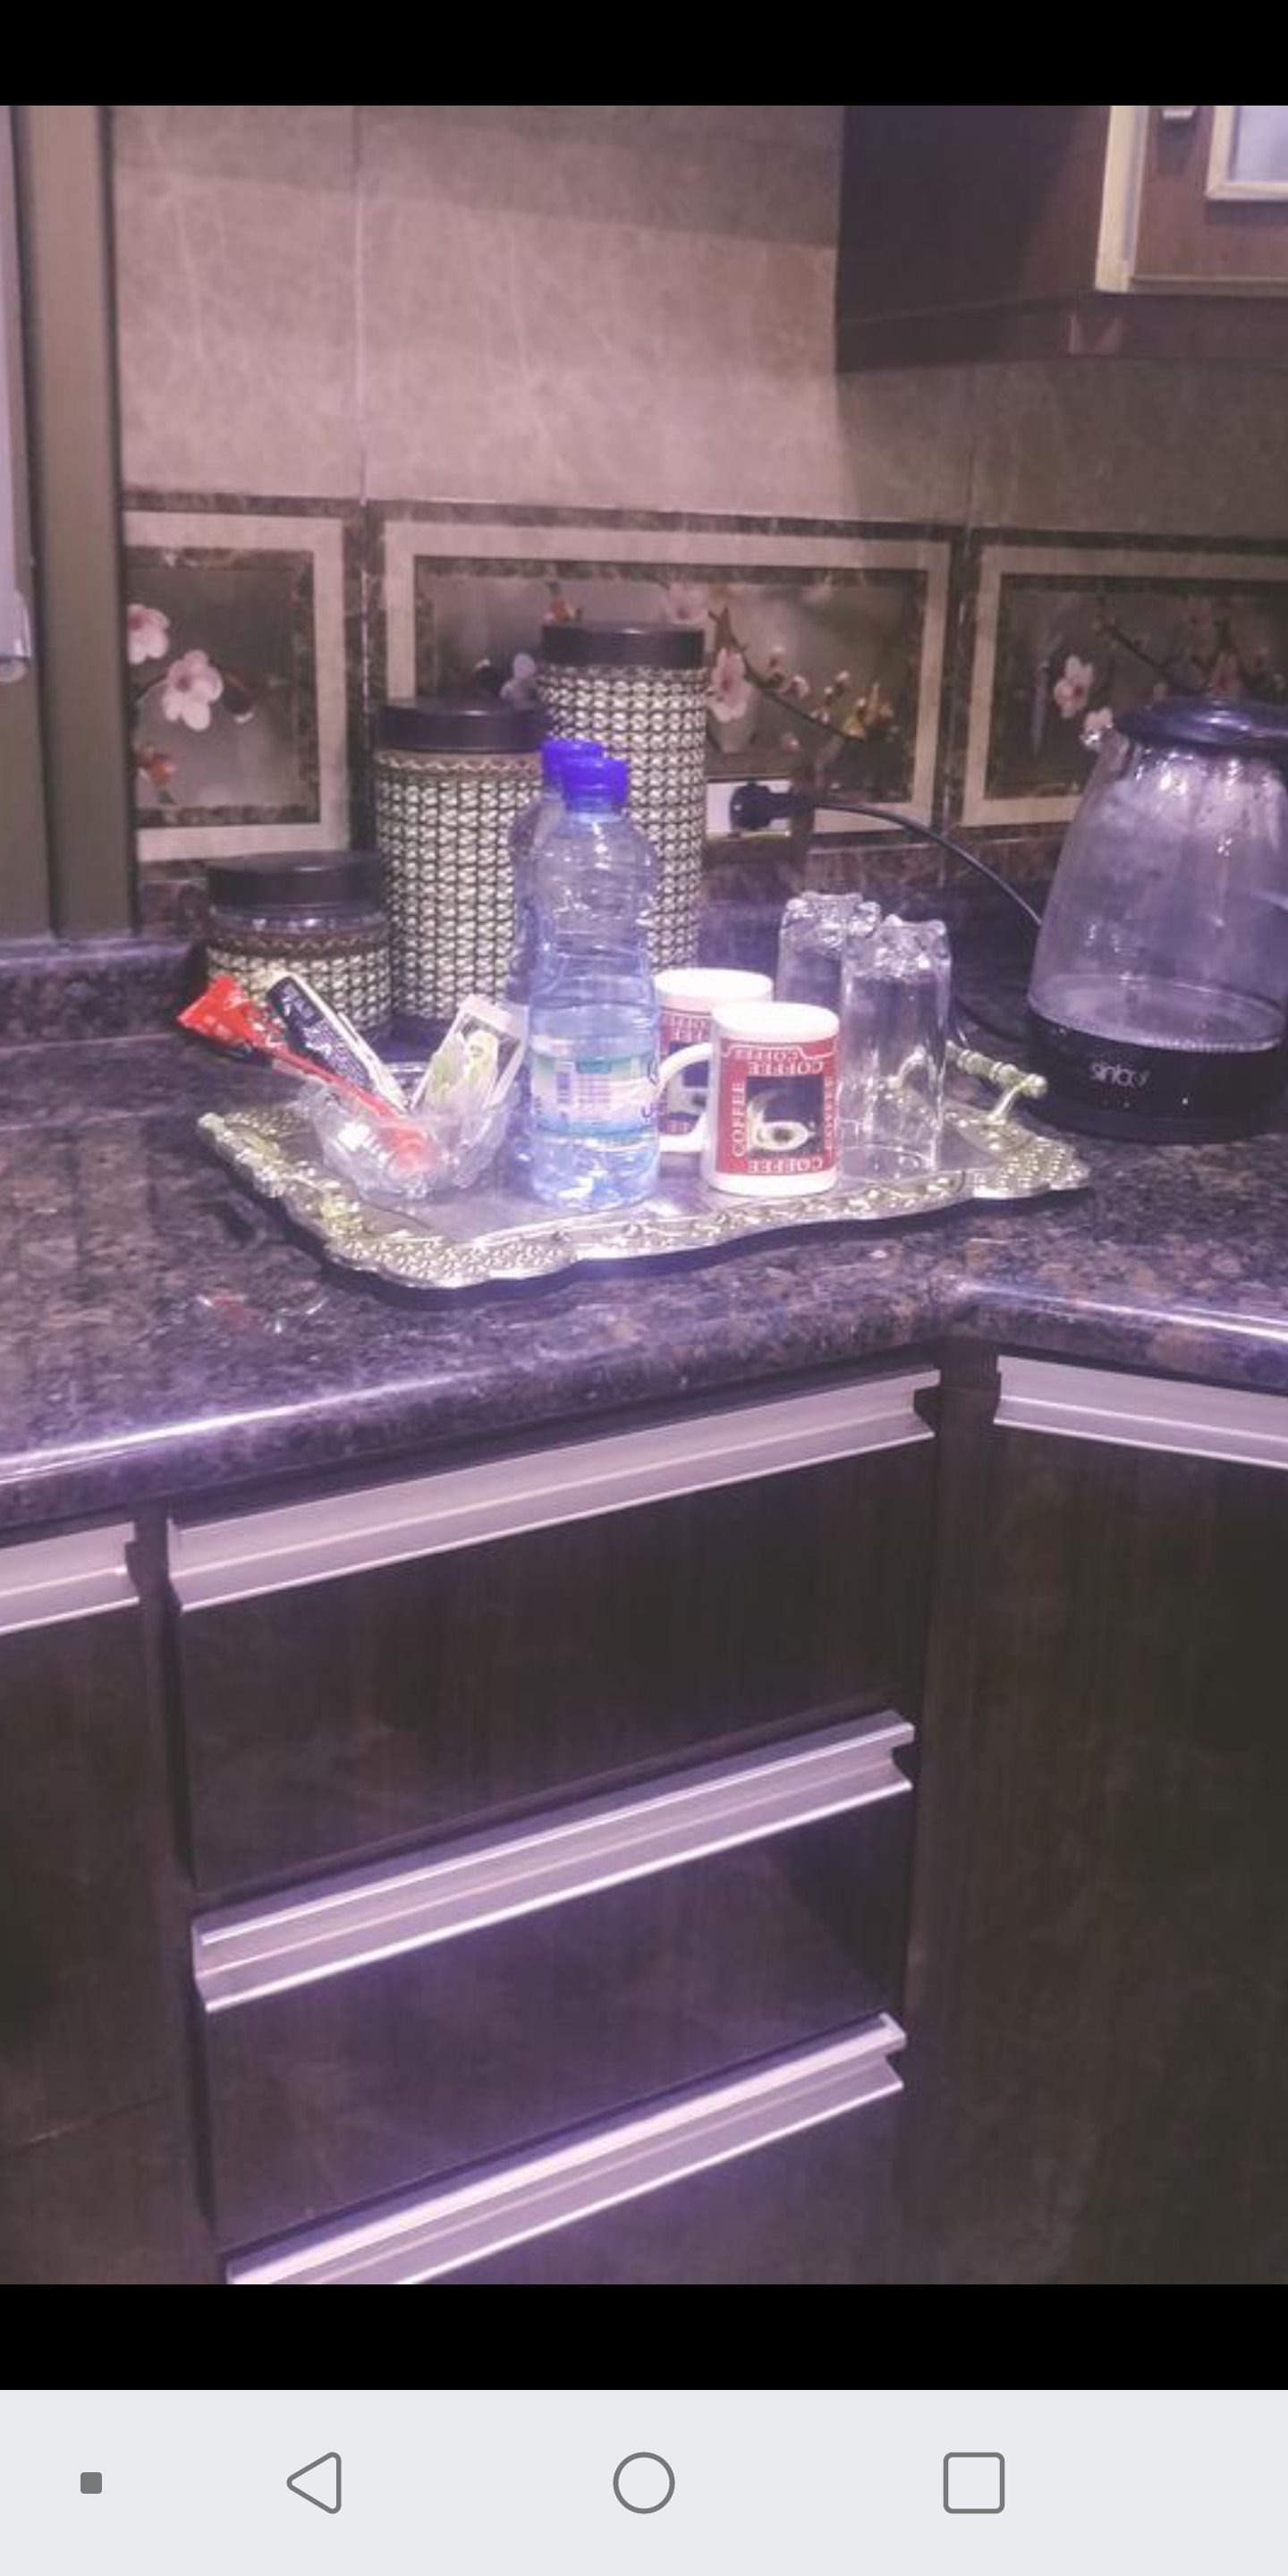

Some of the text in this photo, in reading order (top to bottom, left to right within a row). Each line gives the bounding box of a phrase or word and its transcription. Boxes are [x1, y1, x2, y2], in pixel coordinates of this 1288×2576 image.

[748, 1061, 825, 1075] COFFEE
[732, 1081, 746, 1157] COFFEE
[748, 1157, 824, 1174] COFFEE
